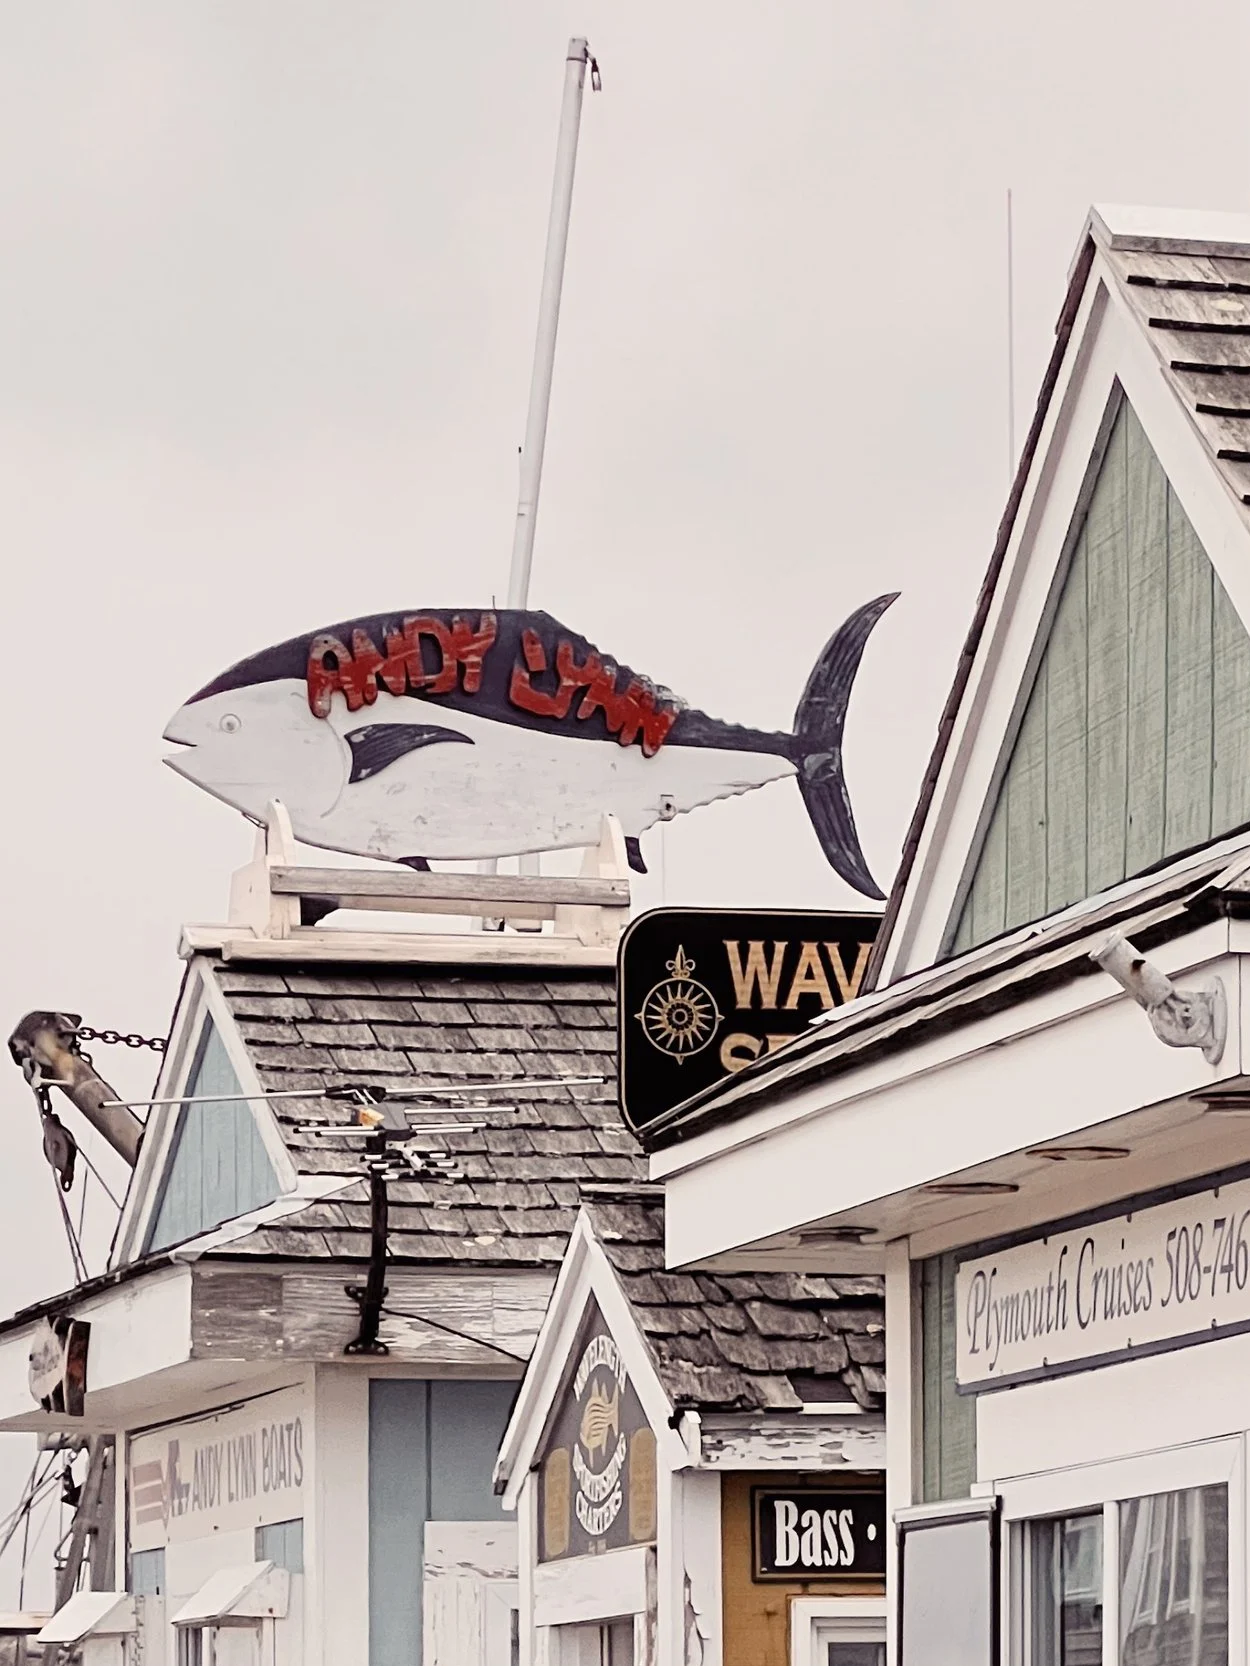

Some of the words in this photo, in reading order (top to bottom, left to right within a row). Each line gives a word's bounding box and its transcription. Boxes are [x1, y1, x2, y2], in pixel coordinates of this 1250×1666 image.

[305, 611, 497, 719] ANDY
[508, 627, 683, 759] LYNN
[966, 1244, 1069, 1372] Plymouth
[1076, 1237, 1154, 1330] Cruises
[192, 1442, 224, 1512] ANDY
[227, 1431, 257, 1503] LYNN
[262, 1416, 304, 1493] BOATS
[773, 1500, 855, 1567] Bass
